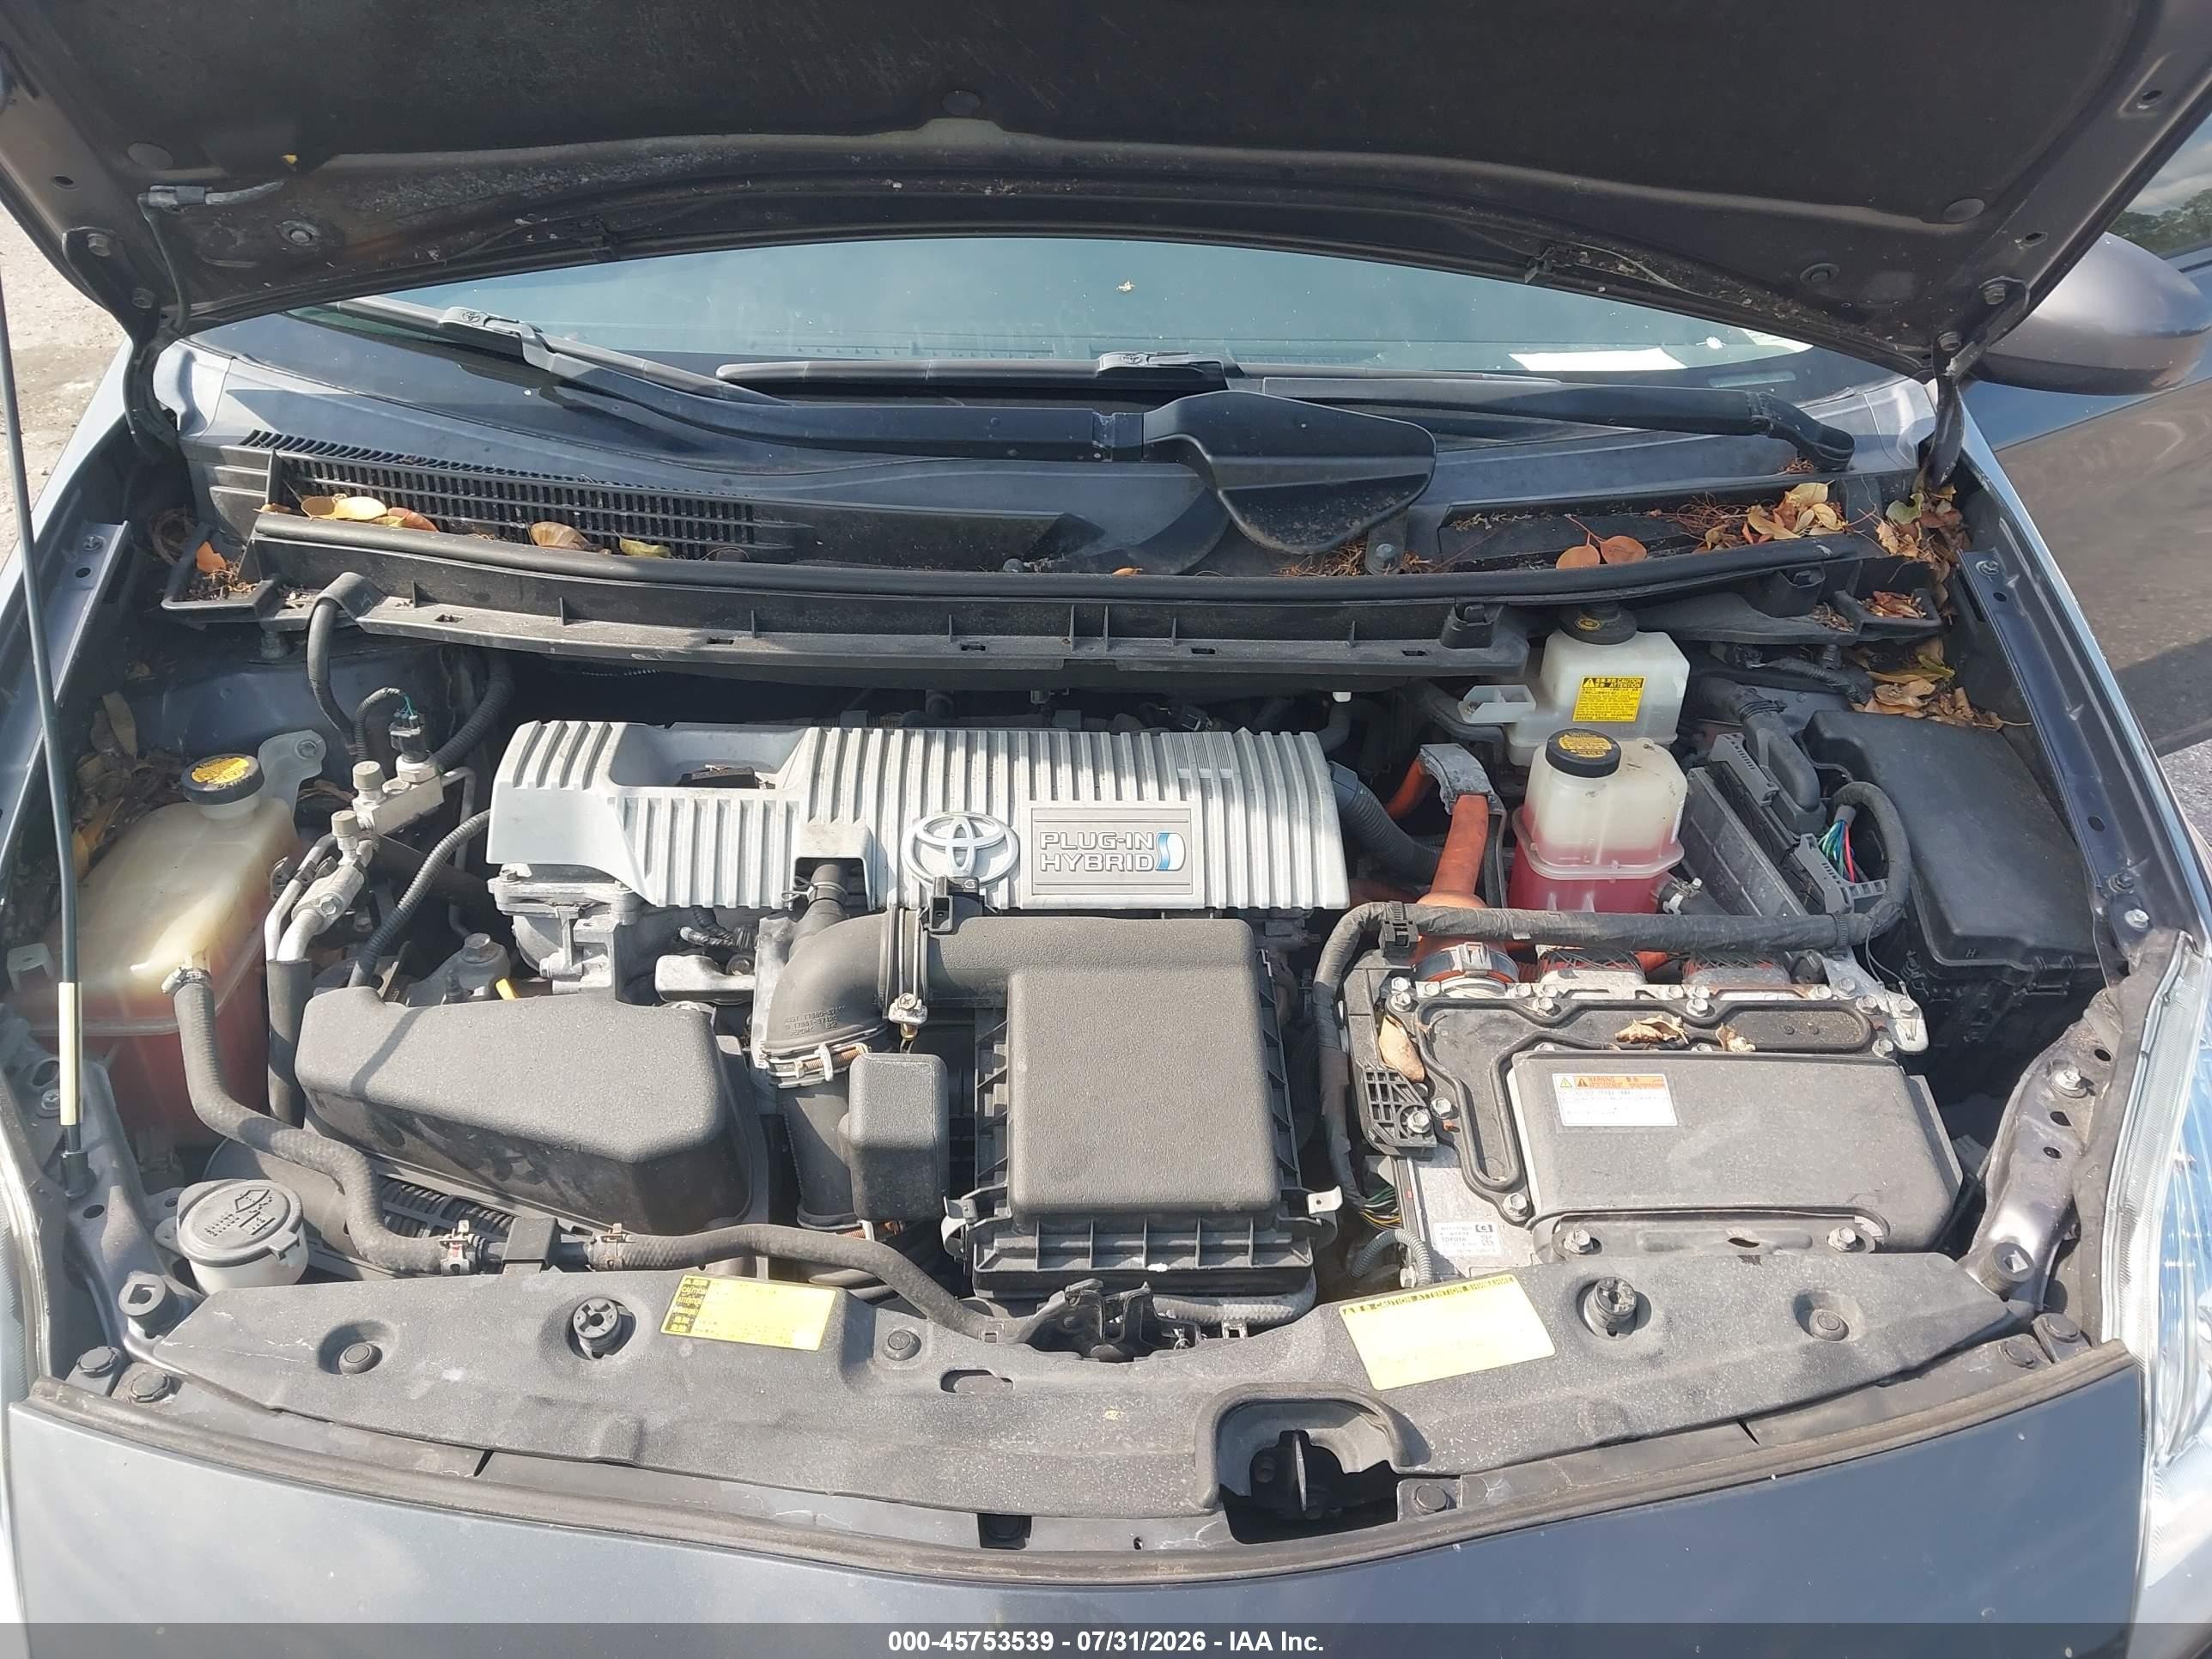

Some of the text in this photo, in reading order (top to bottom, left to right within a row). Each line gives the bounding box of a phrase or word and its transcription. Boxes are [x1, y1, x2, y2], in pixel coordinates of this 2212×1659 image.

[1040, 831, 1154, 850] PLUG-IN
[1040, 854, 1155, 872] HYBRID
[1376, 1285, 1463, 1308] CAUTION ATTENTION
